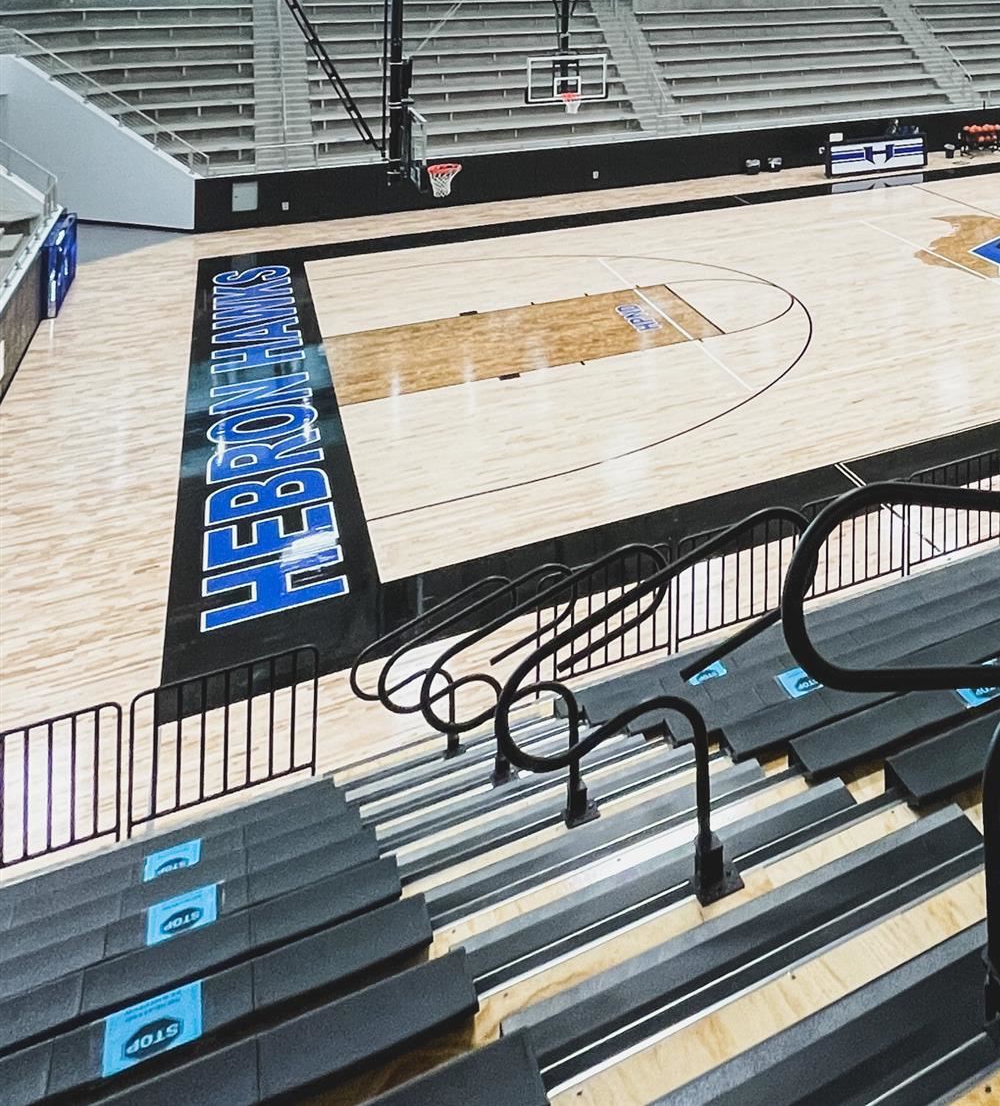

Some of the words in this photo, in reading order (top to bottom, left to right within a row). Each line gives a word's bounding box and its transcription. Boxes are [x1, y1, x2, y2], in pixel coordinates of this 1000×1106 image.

[209, 265, 306, 374] HAWKS
[200, 372, 350, 634] HEBRON
[163, 911, 201, 931] STOP
[126, 1023, 179, 1054] STOP
